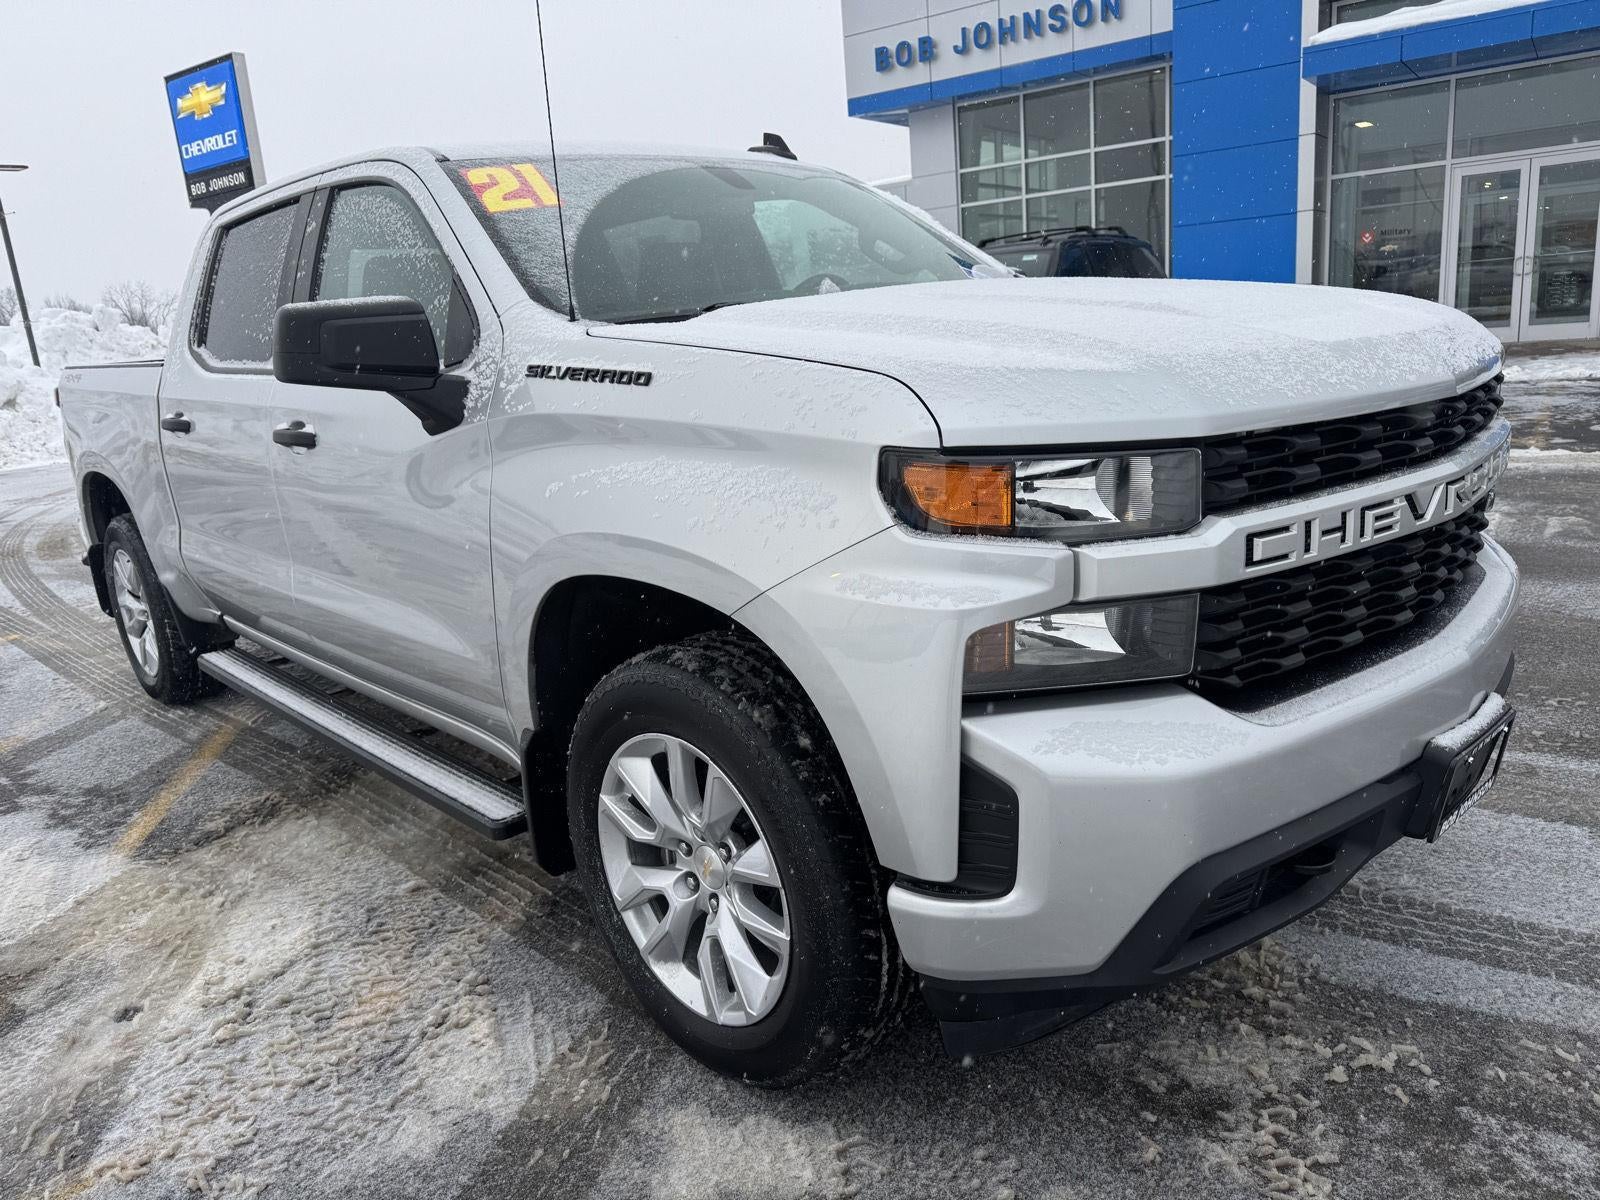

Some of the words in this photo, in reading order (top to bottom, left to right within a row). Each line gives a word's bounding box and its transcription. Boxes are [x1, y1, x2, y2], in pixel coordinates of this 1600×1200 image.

[874, 35, 936, 73] BOB
[952, 0, 1121, 55] JOHNSON
[181, 129, 238, 159] CHEVROLET
[190, 182, 207, 196] BOB
[208, 171, 246, 192] JOHNSON
[466, 163, 560, 214] 21
[525, 364, 653, 387] SILVERADO
